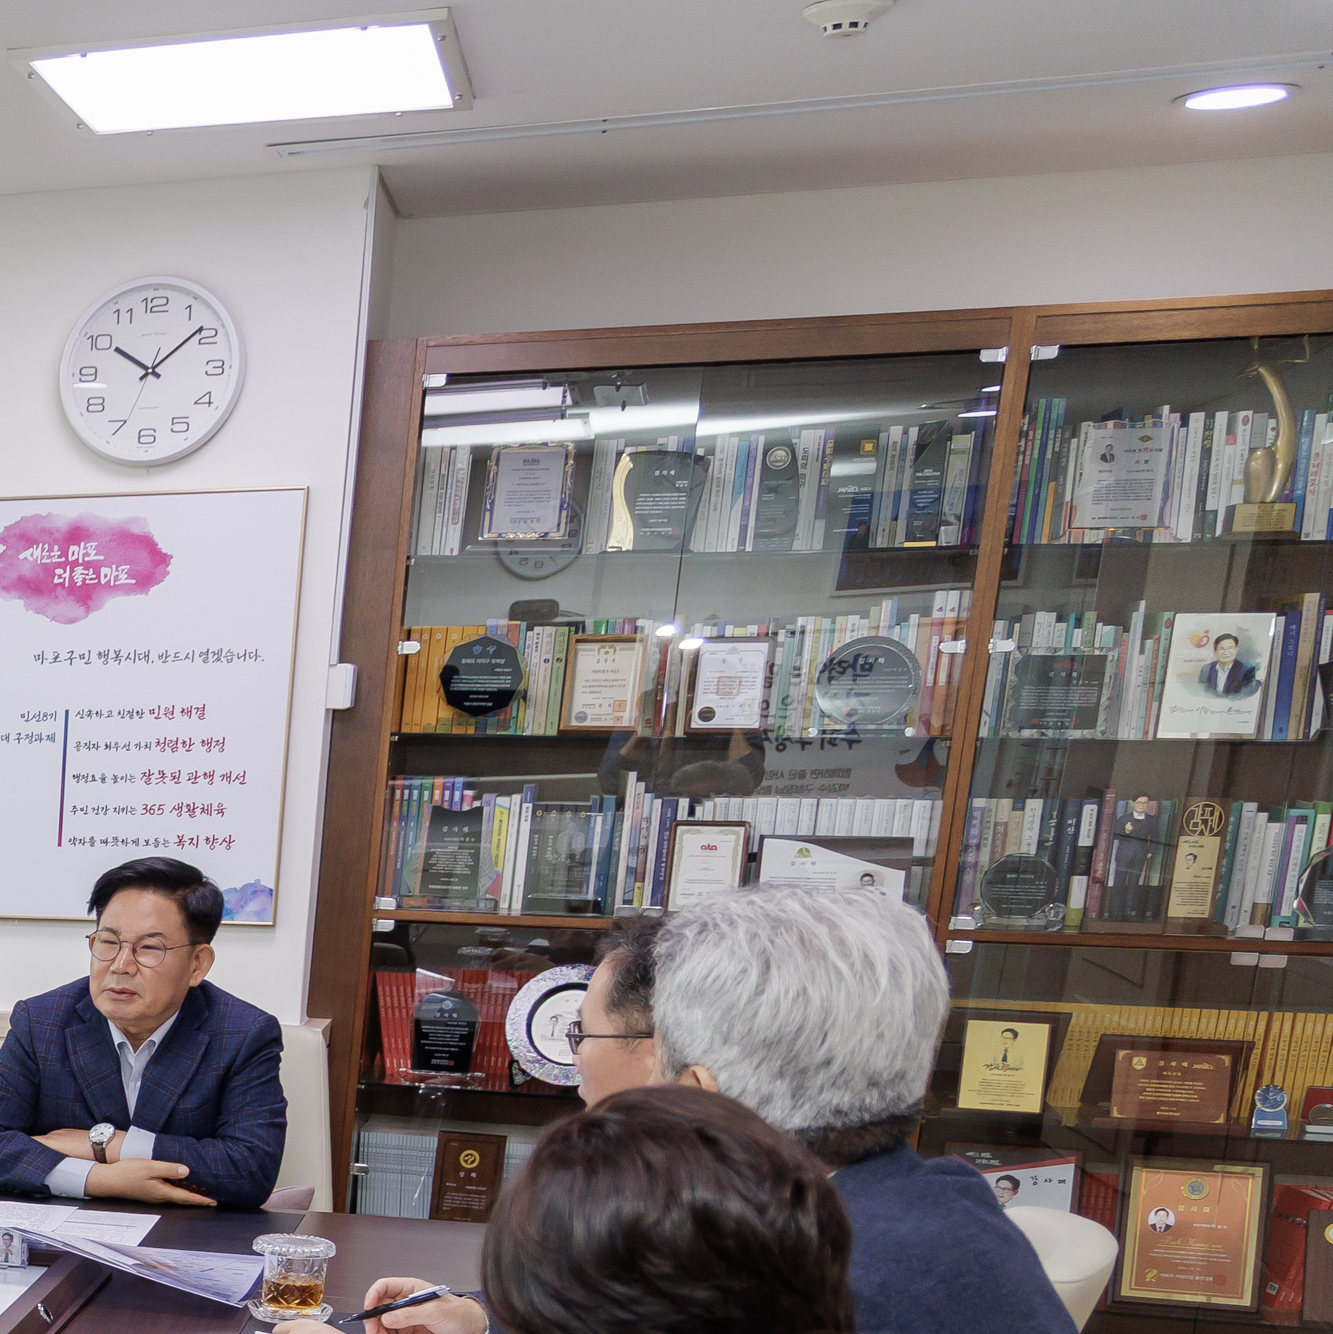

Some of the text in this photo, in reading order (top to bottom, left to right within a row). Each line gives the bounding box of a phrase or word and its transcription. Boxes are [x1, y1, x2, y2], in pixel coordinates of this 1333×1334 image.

[141, 296, 169, 314] 12
[184, 304, 193, 321] 1
[113, 308, 134, 325] 11
[87, 333, 113, 351] 10
[198, 327, 218, 345] 2
[79, 366, 98, 382] 9
[205, 359, 225, 376] 3
[86, 396, 105, 413] 8
[194, 391, 214, 407] 4
[108, 419, 127, 436] 7
[170, 416, 190, 433] 5
[137, 428, 156, 444] 6
[18, 542, 104, 565] 새로운 마포
[53, 564, 136, 587] 더 좋은 마포
[33, 648, 265, 666] 마포구민 행복시대, 반드시 열겠습니다.
[20, 710, 57, 722] 민선8기
[74, 703, 207, 721] 신속하고 친절한 민원 해결
[13, 731, 56, 744] 구정과제
[154, 736, 195, 753] 청렴한
[199, 736, 226, 753] 행정
[139, 769, 182, 786] 잘못된
[185, 770, 216, 786] 관행
[219, 770, 248, 785] 개선
[69, 804, 89, 816] 주민
[90, 804, 110, 816] 건강
[140, 803, 166, 816] 365
[169, 802, 227, 818] 생활체육
[173, 834, 200, 849] 복지
[203, 834, 235, 850] 향상
